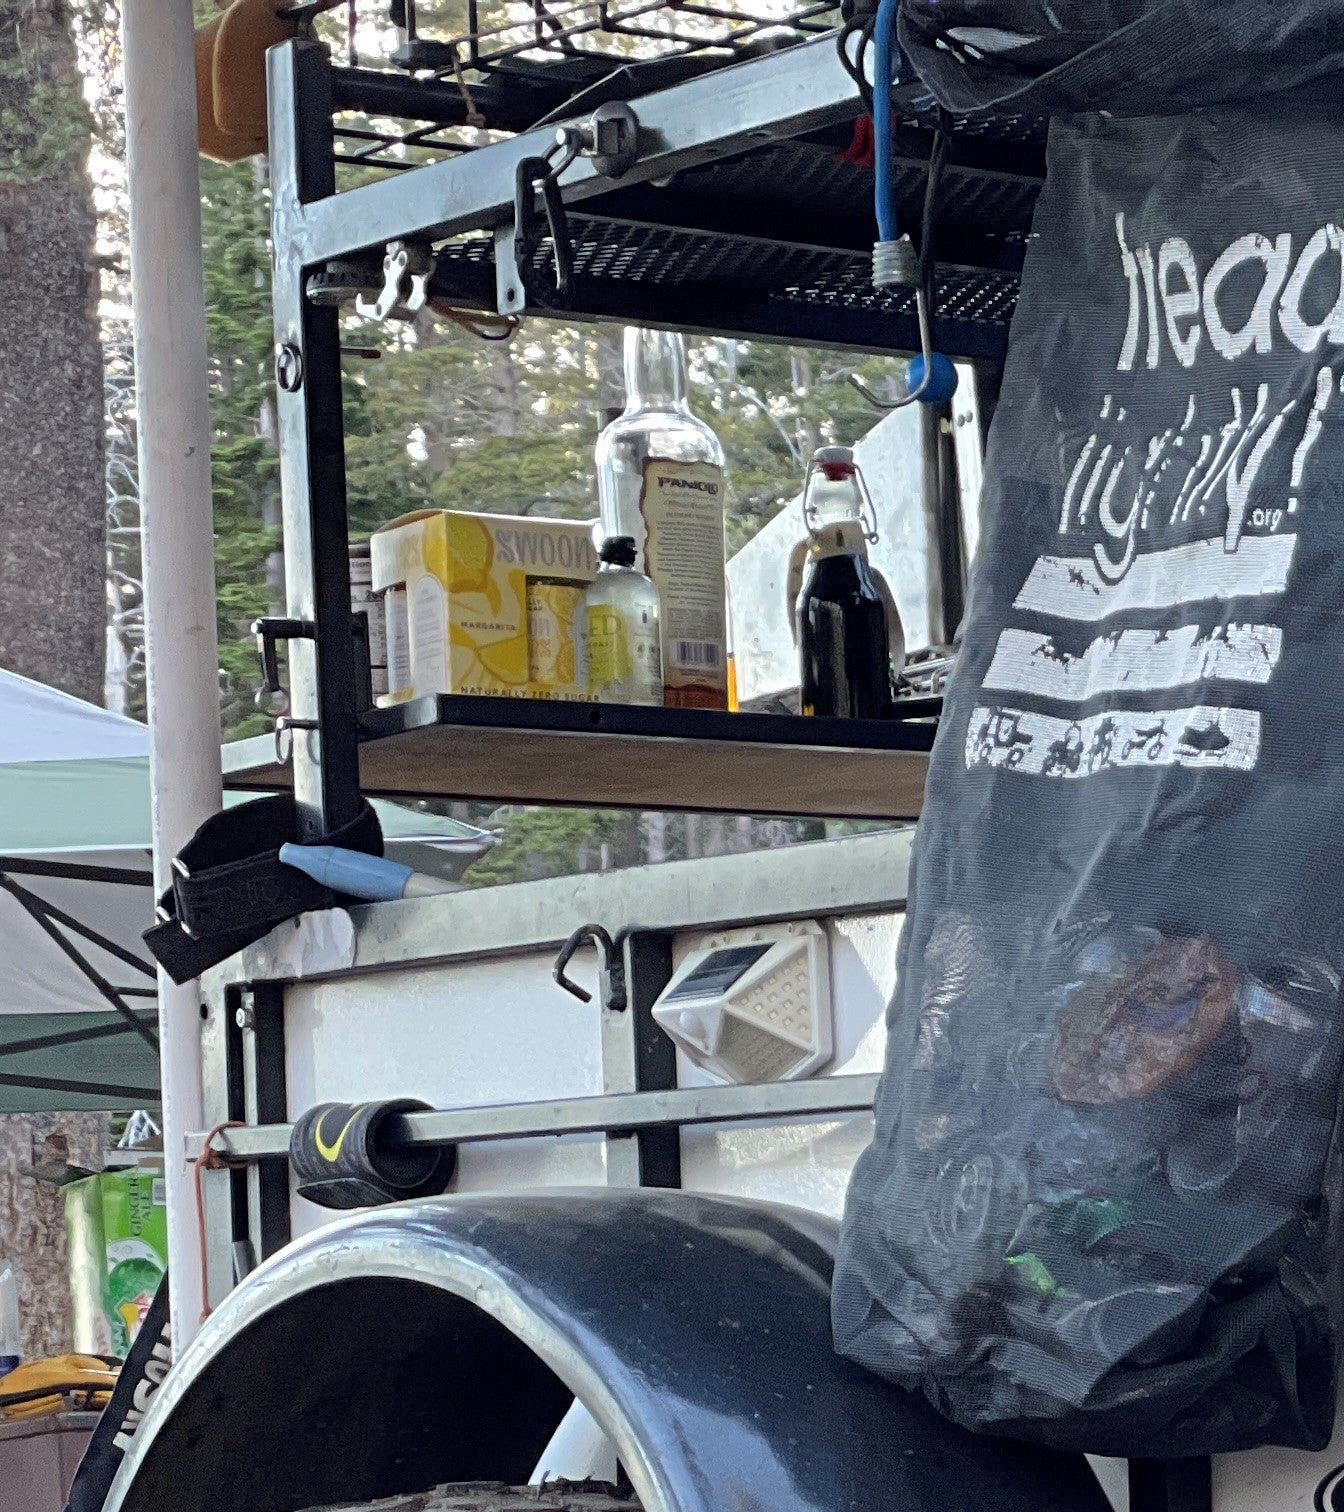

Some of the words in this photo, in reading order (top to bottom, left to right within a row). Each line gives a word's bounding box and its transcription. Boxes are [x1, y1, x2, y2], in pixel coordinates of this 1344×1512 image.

[1246, 506, 1283, 531] .org
[495, 529, 594, 571] SWOON
[461, 686, 527, 698] NATURALLY
[532, 690, 560, 701] ZERO
[564, 692, 600, 703] SUGAR
[129, 1177, 142, 1237] GINGER
